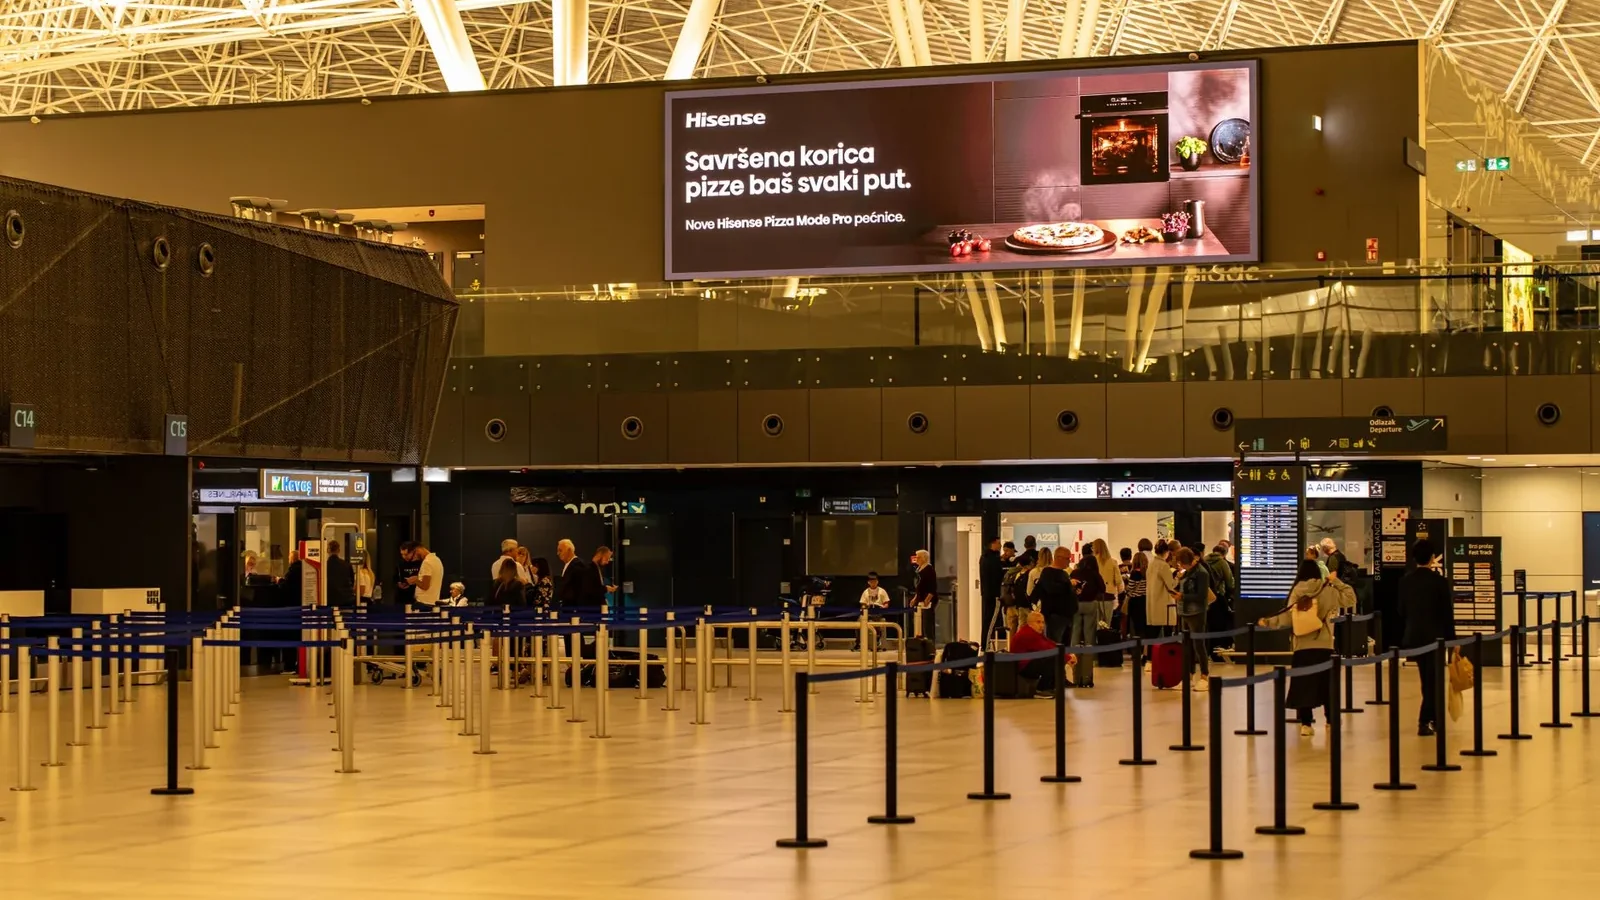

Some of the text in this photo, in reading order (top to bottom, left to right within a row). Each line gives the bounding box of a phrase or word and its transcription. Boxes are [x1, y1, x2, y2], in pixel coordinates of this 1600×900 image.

[685, 112, 766, 128] Hisense
[685, 142, 875, 172] Savršena korica
[685, 168, 912, 203] pizze baš svaki put.
[685, 211, 906, 231] Nove Hisense Pizza Mode Pro pećnice.
[14, 409, 34, 428] C14
[170, 420, 187, 437] C15
[1004, 484, 1088, 494] CROATIA AIRLINES
[1137, 483, 1222, 493] CROATIA AIRLINES
[1316, 483, 1360, 492] AIRLINES
[1036, 533, 1058, 541] A220
